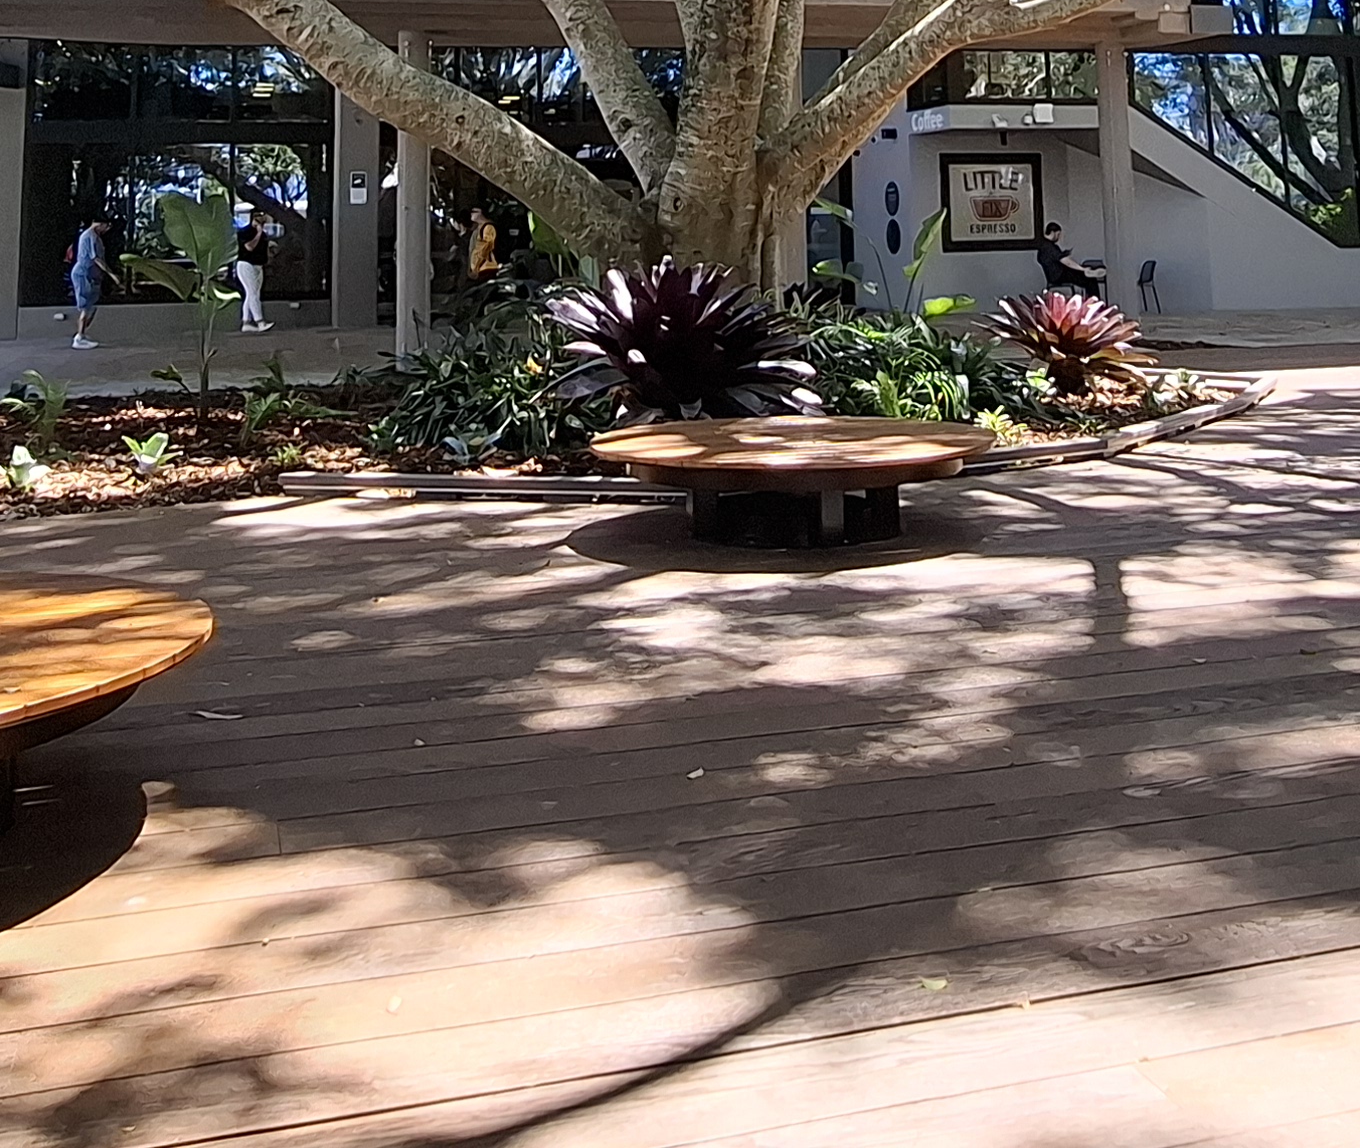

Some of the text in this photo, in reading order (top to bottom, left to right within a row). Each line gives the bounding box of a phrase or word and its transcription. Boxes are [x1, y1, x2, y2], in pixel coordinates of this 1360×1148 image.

[911, 110, 944, 131] Coffee
[963, 170, 1018, 191] LITTLE
[970, 223, 1016, 234] ESPRESSO
